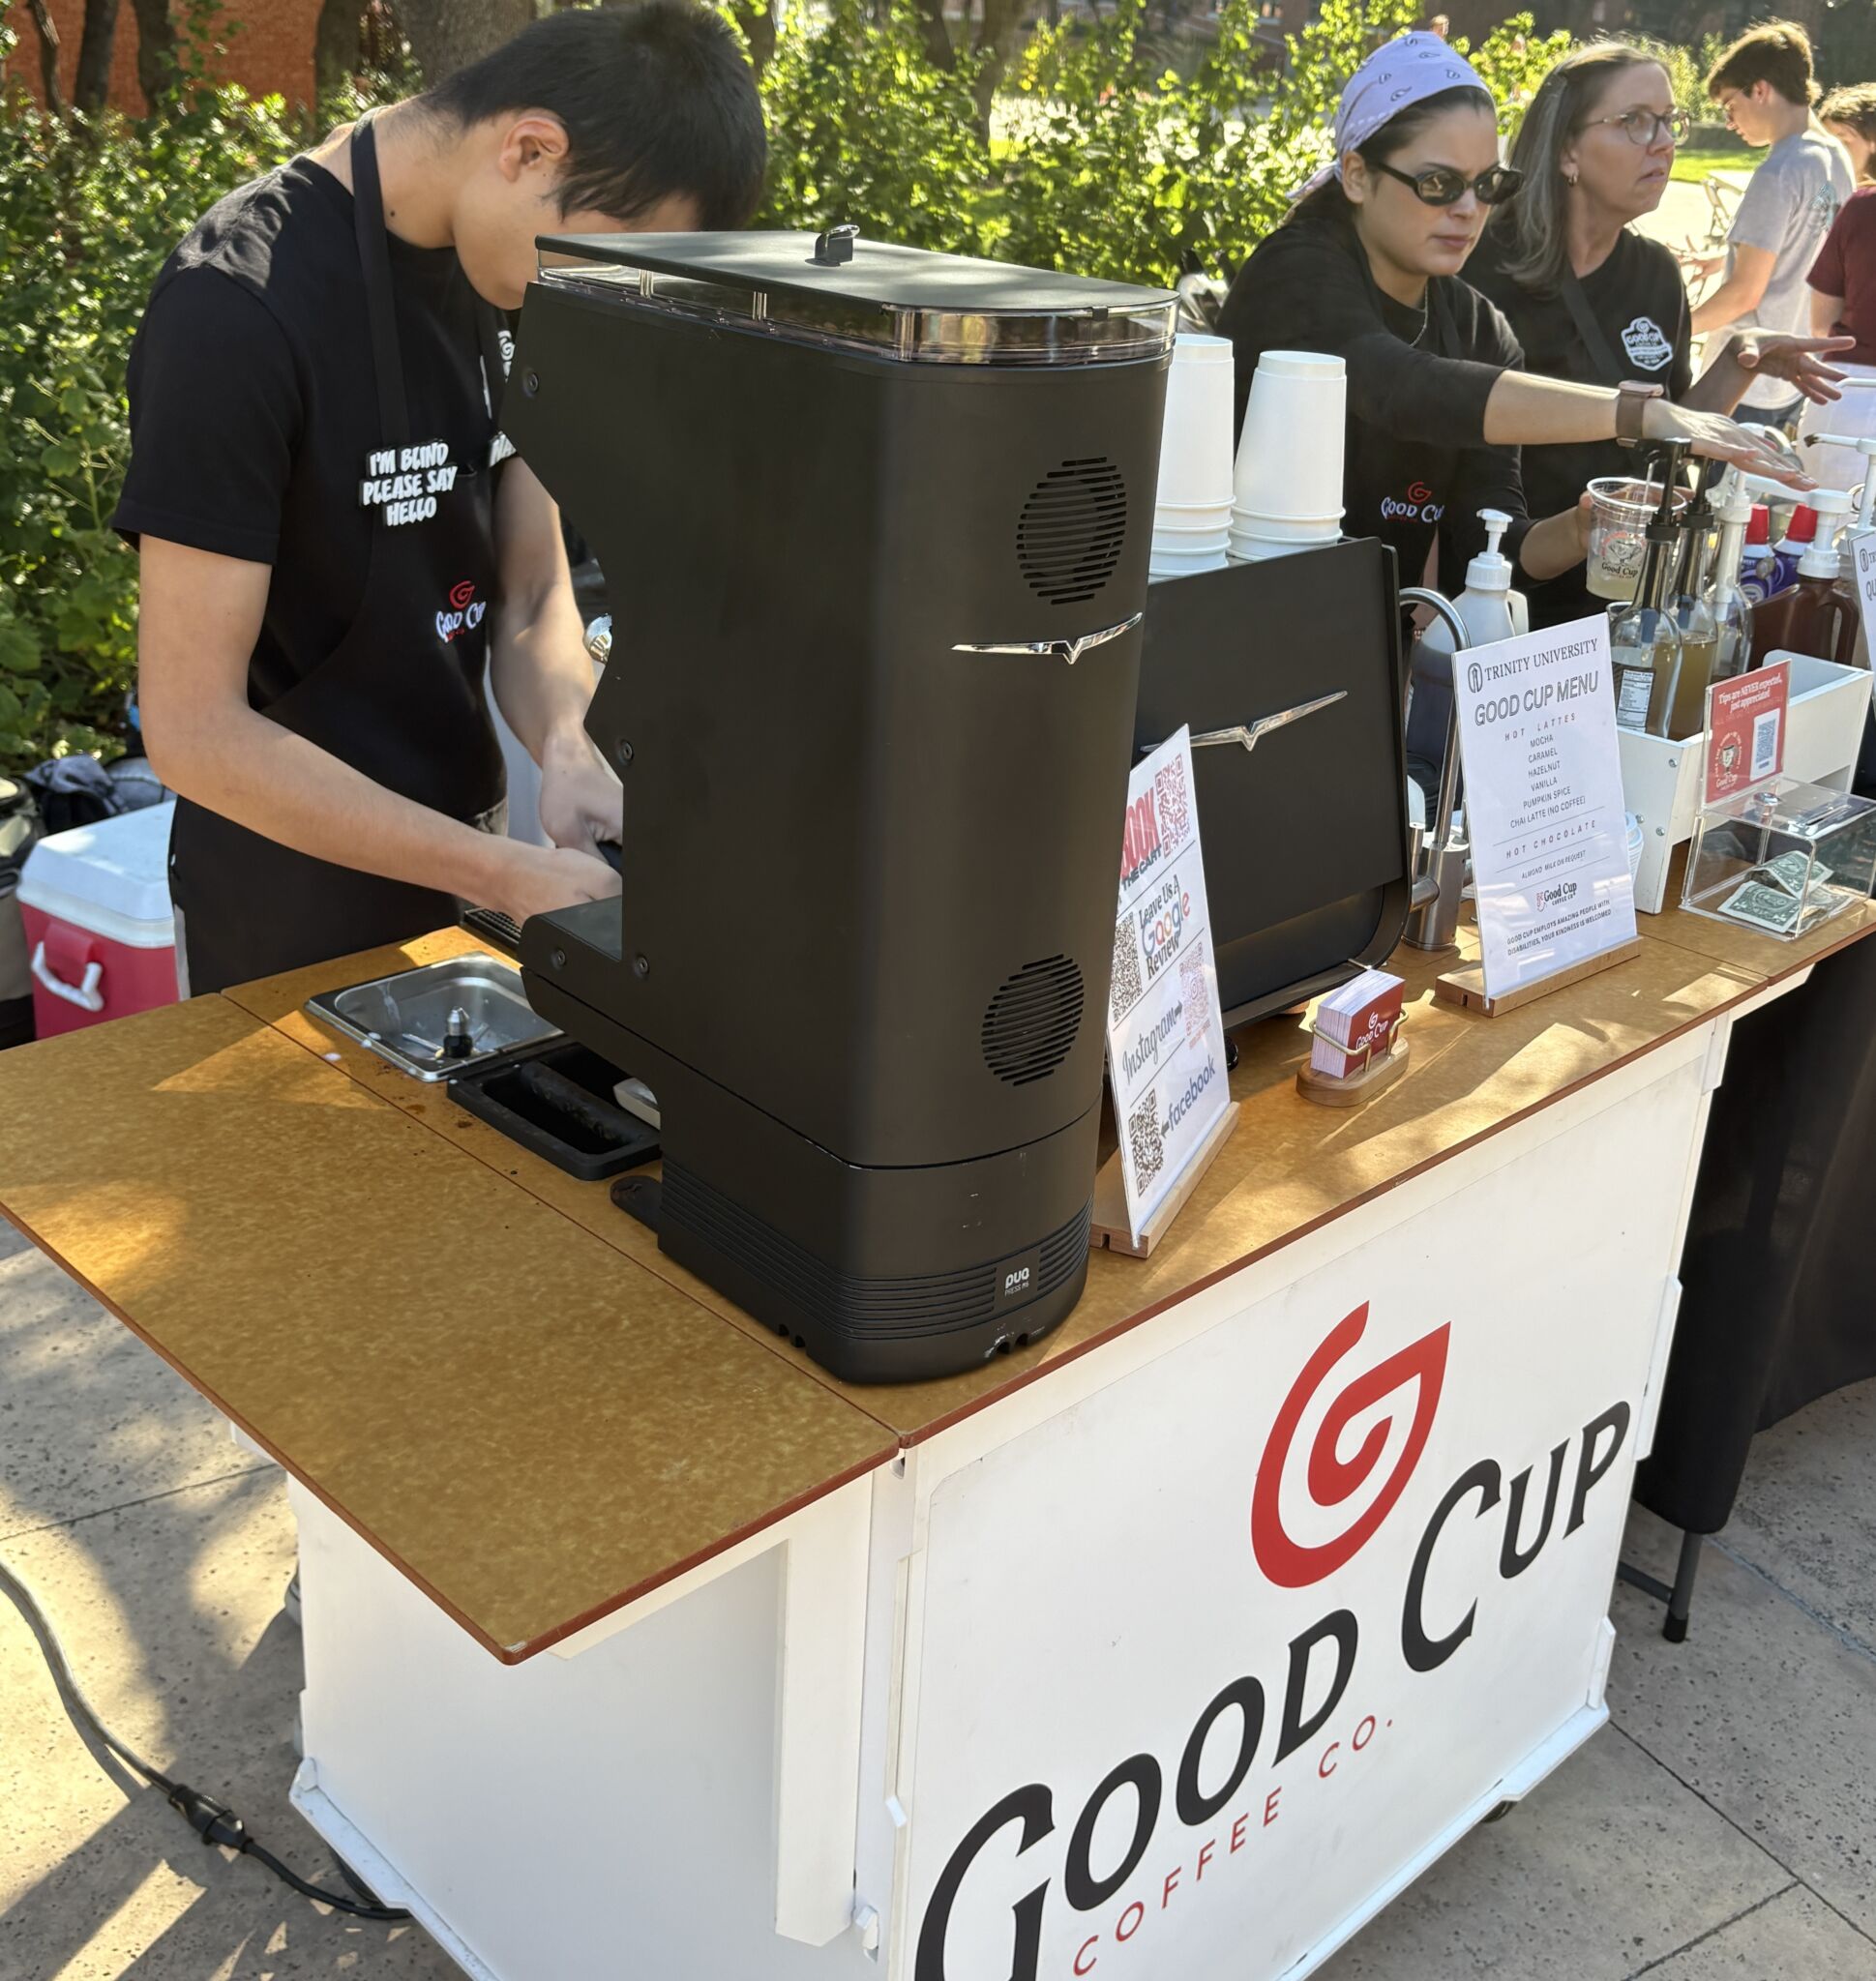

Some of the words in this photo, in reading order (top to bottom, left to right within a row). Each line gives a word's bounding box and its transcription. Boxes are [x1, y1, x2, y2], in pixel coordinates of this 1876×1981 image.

[370, 449, 396, 477] I'M
[401, 441, 449, 473] BLIND
[363, 473, 424, 506] PLEASE
[427, 466, 458, 494] SAY
[387, 496, 437, 527] HELLO
[1421, 504, 1445, 523] CU
[1484, 656, 1531, 681] TRINITY
[1534, 638, 1598, 667] UNIVERSITY
[1474, 694, 1520, 725] GOOD
[1523, 684, 1554, 712] CUP
[1557, 670, 1599, 702] MENU
[1504, 727, 1526, 742] HOT
[1537, 712, 1576, 732] LATTES
[1530, 734, 1554, 748] MOCHA
[1528, 748, 1558, 763] CARAMEL
[1528, 760, 1561, 778] HAZELNUT
[1523, 792, 1552, 809] PUMPKIN
[1553, 786, 1571, 801] SPICE
[1531, 777, 1558, 792] VANILLA
[1510, 814, 1526, 829] CHAI
[1527, 808, 1547, 823] LATTE
[1505, 844, 1527, 859] HOT
[1534, 820, 1596, 849] CHOCOLATE
[1121, 867, 1140, 891] THE
[1140, 843, 1162, 874] CART
[1521, 866, 1543, 879] ALMOND
[1544, 861, 1556, 872] MILK
[1564, 850, 1587, 865] REQUEST
[1139, 895, 1162, 930] Leave
[1162, 883, 1174, 903] Us
[1174, 874, 1180, 895] A
[1544, 883, 1562, 902] Good
[1563, 881, 1577, 898] Cup
[1143, 889, 1191, 957] Google
[1506, 933, 1522, 945] GOOD
[1522, 929, 1534, 939] CUP
[1534, 920, 1557, 934] EMPLOYS
[1557, 911, 1579, 925] AMAZING
[1579, 904, 1597, 916] PEOPLE
[1597, 899, 1610, 909] WITH
[1541, 931, 1555, 942] YOUR
[1555, 922, 1580, 936] KINDNESS
[1586, 908, 1612, 924] WELCOMED
[1146, 931, 1181, 980] Review
[1122, 1008, 1177, 1085] Instagram
[1168, 1054, 1216, 1132] facebook
[914, 1608, 1359, 1981] GOOD
[1401, 1400, 1631, 1672] CUP
[1073, 1787, 1284, 1977] COFFEE
[1318, 1715, 1394, 1780] CO.
